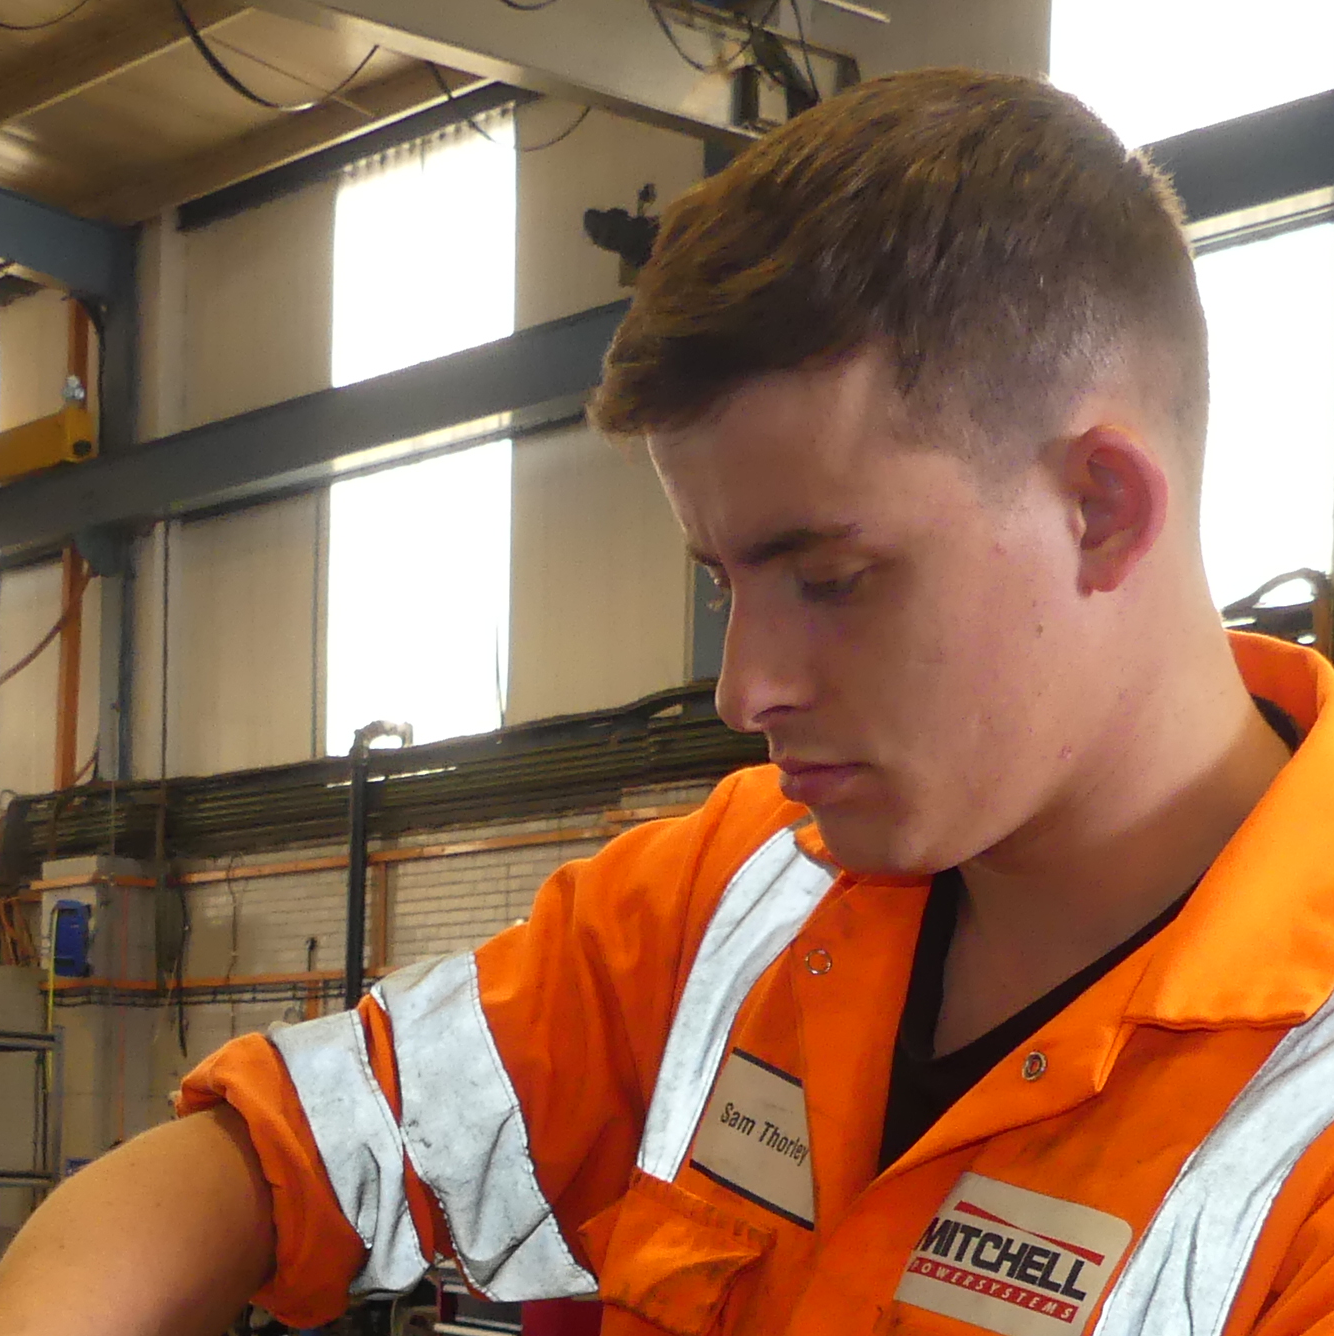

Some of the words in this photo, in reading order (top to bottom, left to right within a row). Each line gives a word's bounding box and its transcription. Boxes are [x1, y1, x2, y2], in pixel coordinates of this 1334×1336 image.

[720, 1102, 756, 1136] Sam
[759, 1121, 808, 1167] Thorley
[910, 1260, 1074, 1320] POWERSYSTEMS
[915, 1217, 1087, 1302] MITCHELL
